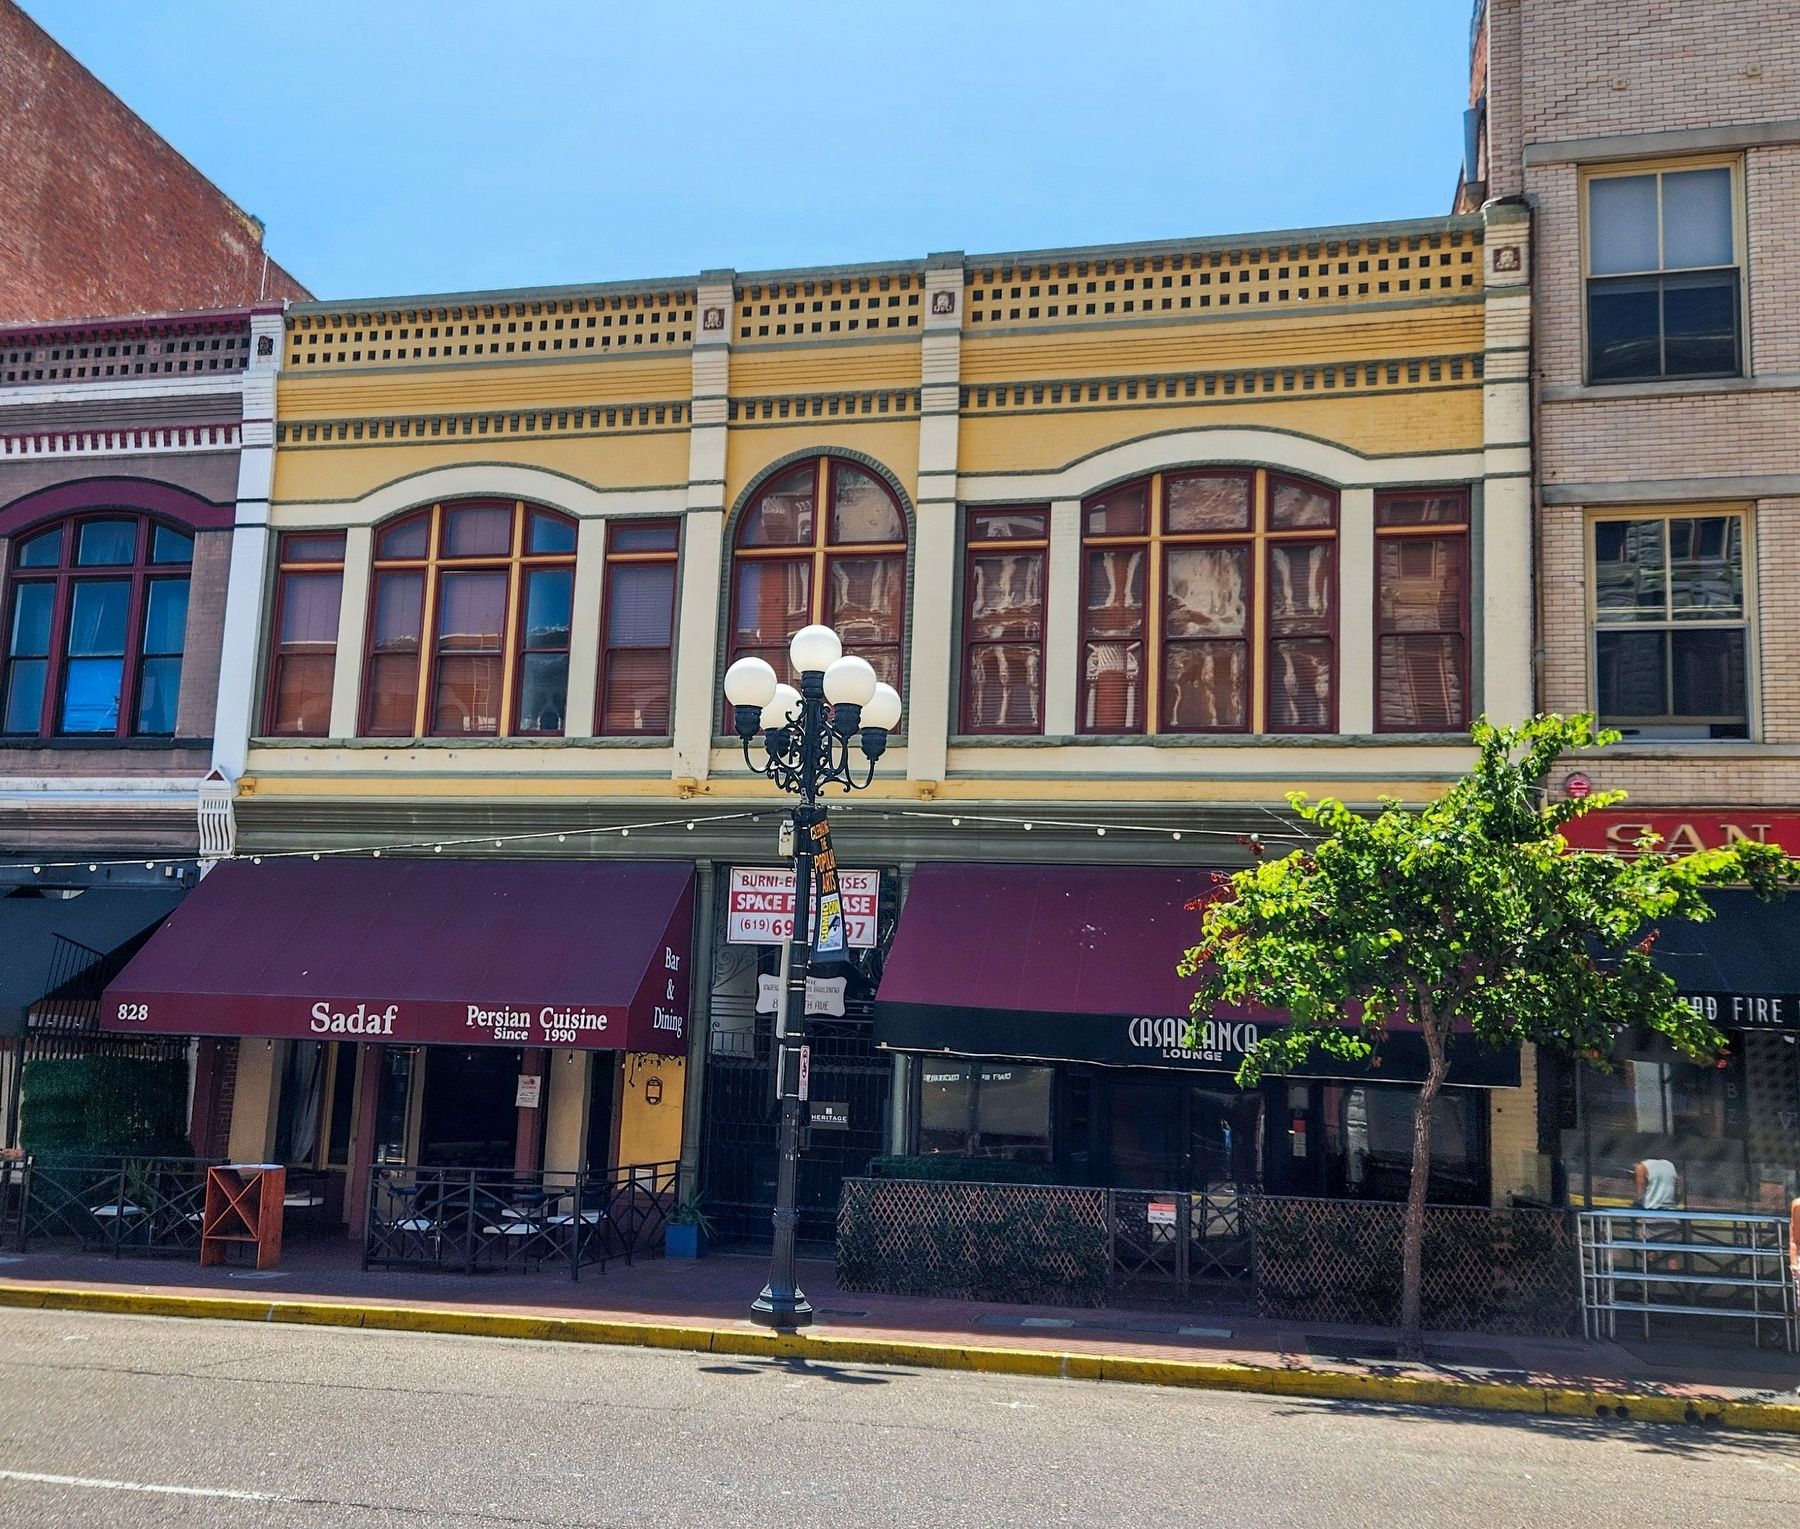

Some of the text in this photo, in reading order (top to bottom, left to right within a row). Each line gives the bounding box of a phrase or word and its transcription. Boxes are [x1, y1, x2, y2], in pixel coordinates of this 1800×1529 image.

[737, 894, 785, 911] SPACE
[787, 895, 817, 911] FR
[843, 897, 870, 913] ASE
[740, 918, 770, 932] (619)
[821, 902, 830, 944] COMIC
[829, 899, 840, 914] CON
[665, 946, 680, 971] Bar
[666, 978, 675, 1000] &
[117, 1004, 148, 1021] 828
[814, 1001, 829, 1010] AVE
[1733, 997, 1782, 1023] FIRE
[310, 1002, 398, 1035] Sadaf
[466, 1005, 608, 1030] Persian Cuisine
[653, 1006, 683, 1038] Dining
[493, 1027, 577, 1042] Since 1990
[1128, 1017, 1258, 1053] CASABANCA
[1162, 1049, 1222, 1061] LOUNGE
